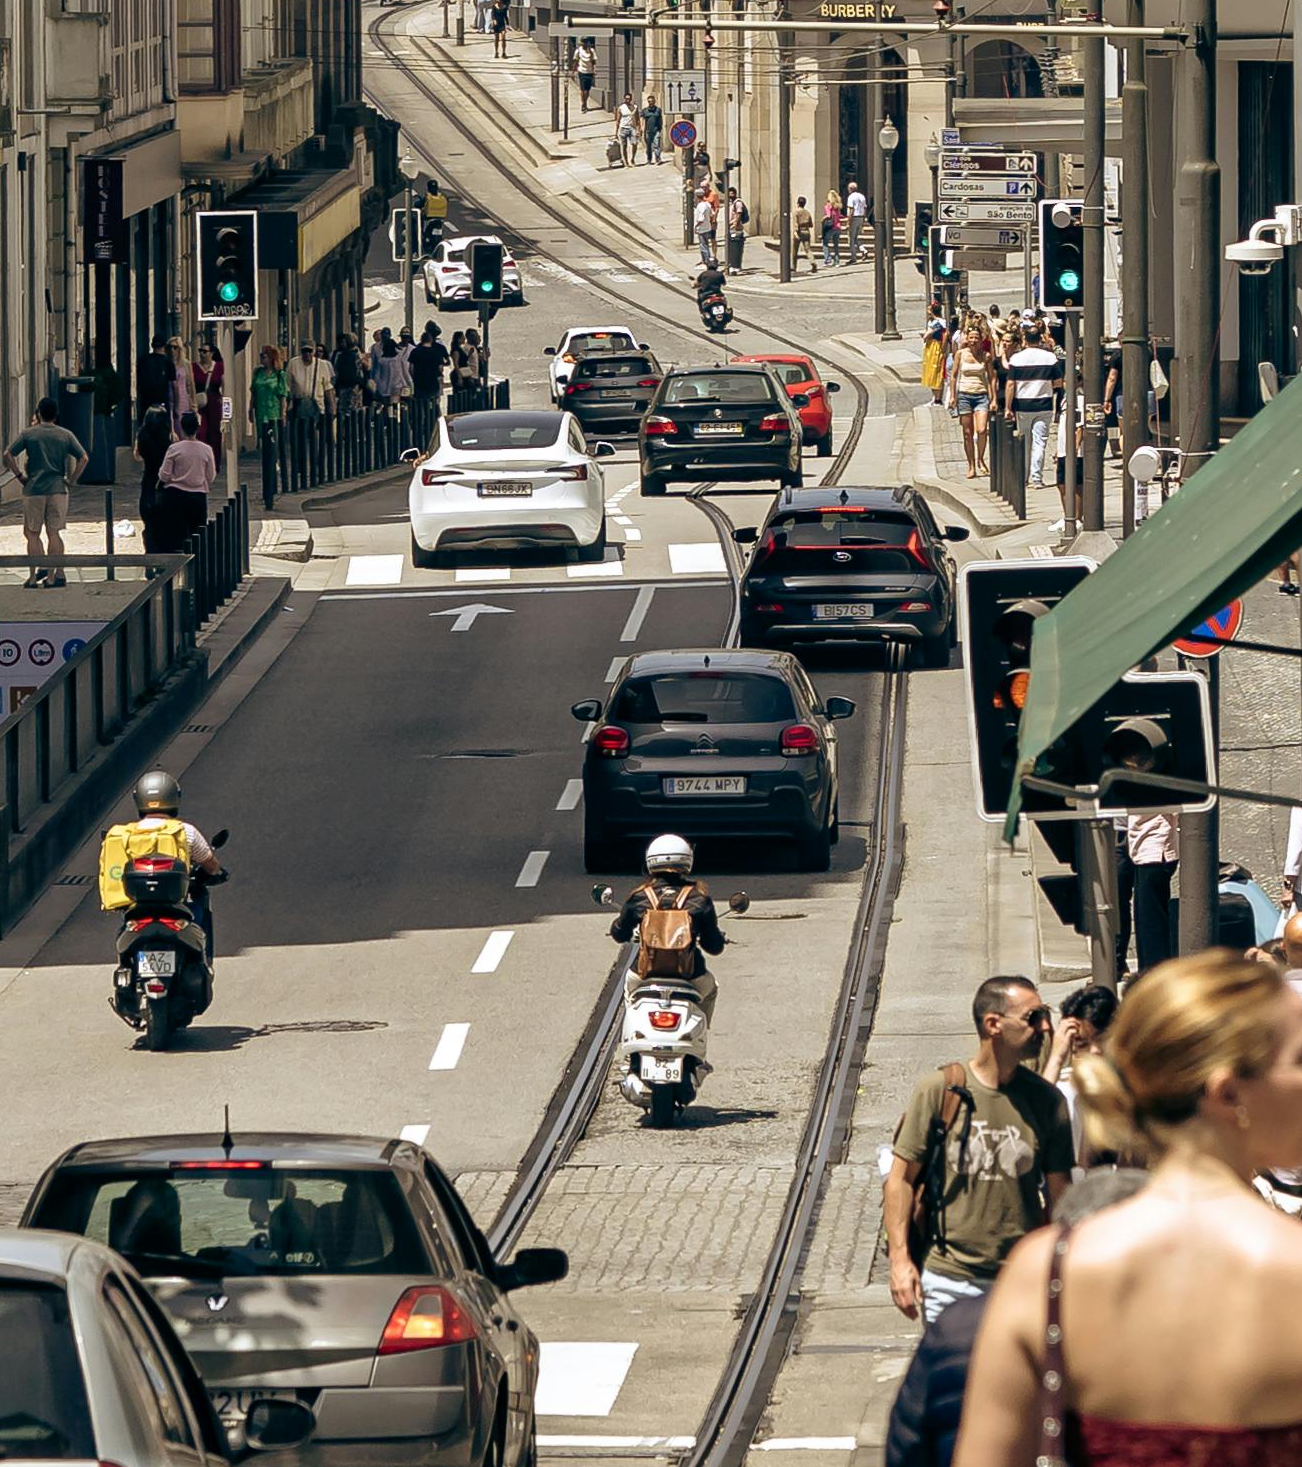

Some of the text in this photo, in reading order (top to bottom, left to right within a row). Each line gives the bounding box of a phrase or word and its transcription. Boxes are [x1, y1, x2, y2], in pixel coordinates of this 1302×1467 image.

[942, 182, 985, 191] Cardosas
[987, 210, 1033, 219] São Bento
[824, 605, 867, 616] BI57CS
[2, 647, 14, 658] 10
[676, 778, 740, 792] 9744 MPY
